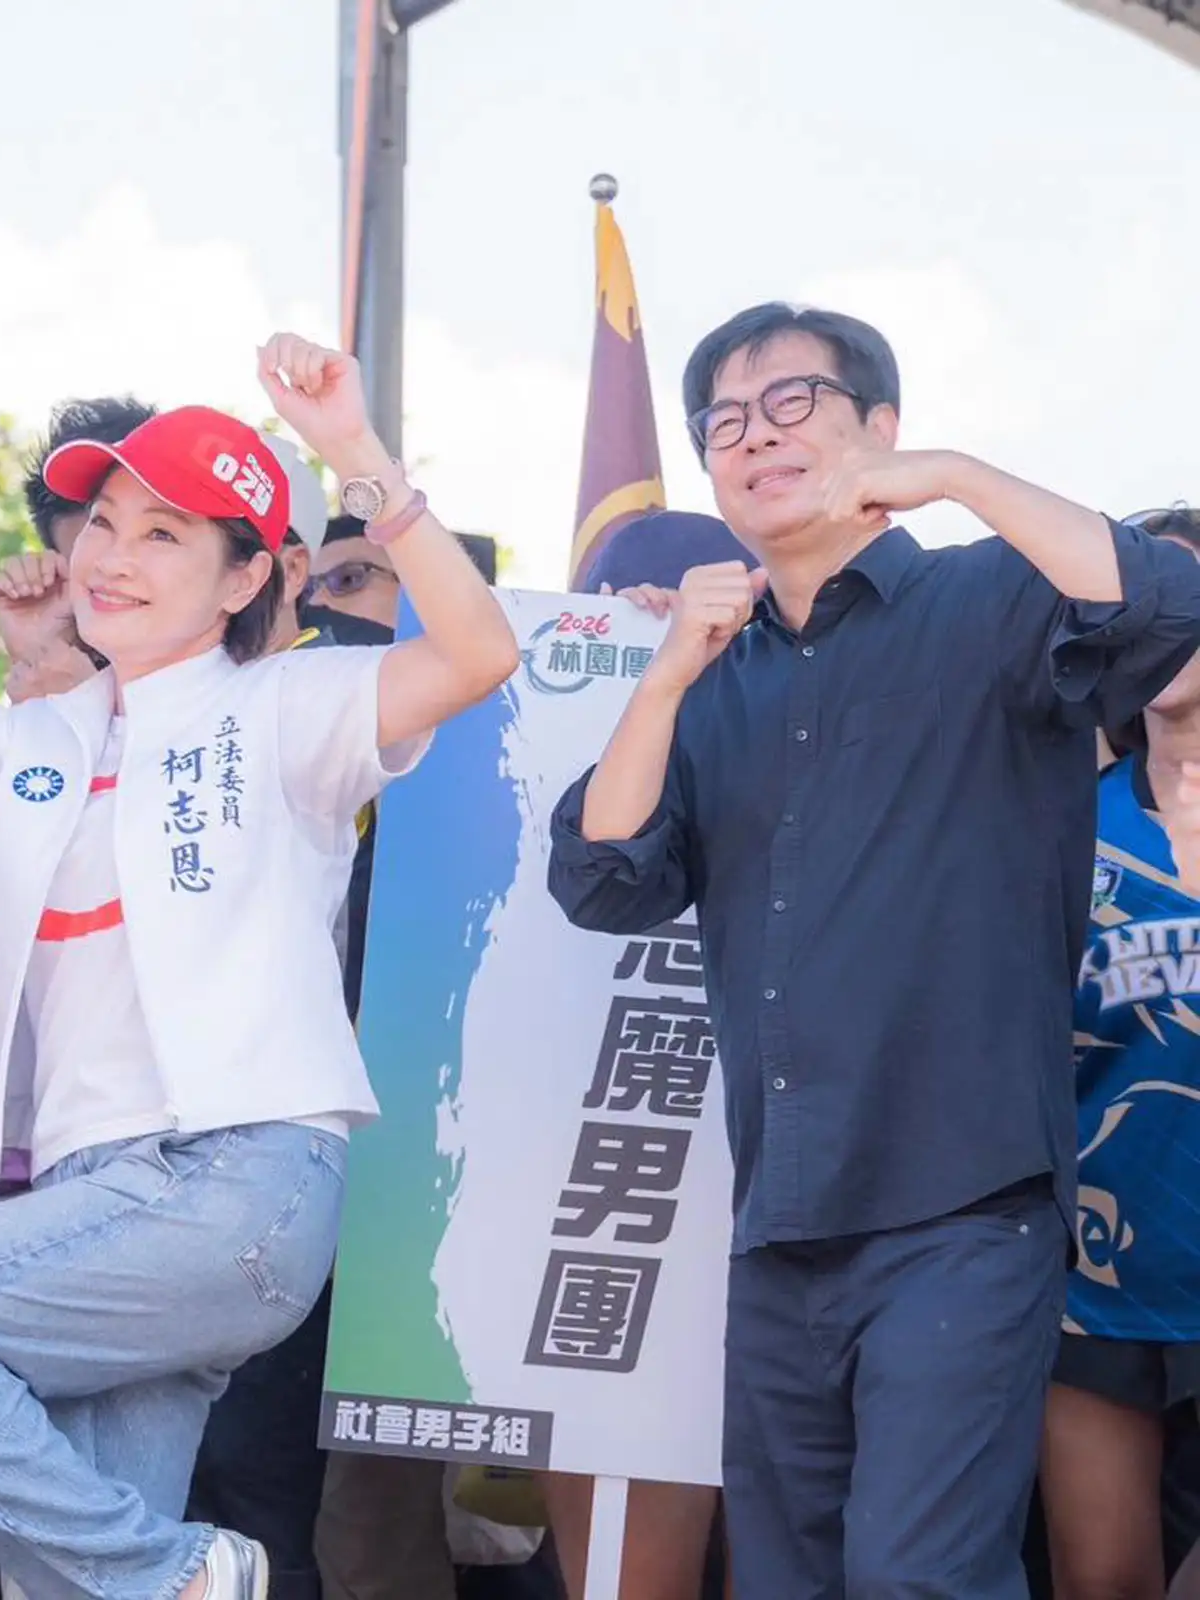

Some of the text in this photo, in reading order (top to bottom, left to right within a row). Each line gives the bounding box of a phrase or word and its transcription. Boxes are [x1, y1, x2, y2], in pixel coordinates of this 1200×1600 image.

[556, 612, 611, 634] 2026
[214, 716, 245, 829] 立法委員
[161, 747, 214, 893] 柯志恩
[333, 1399, 531, 1457] 社會男子組
